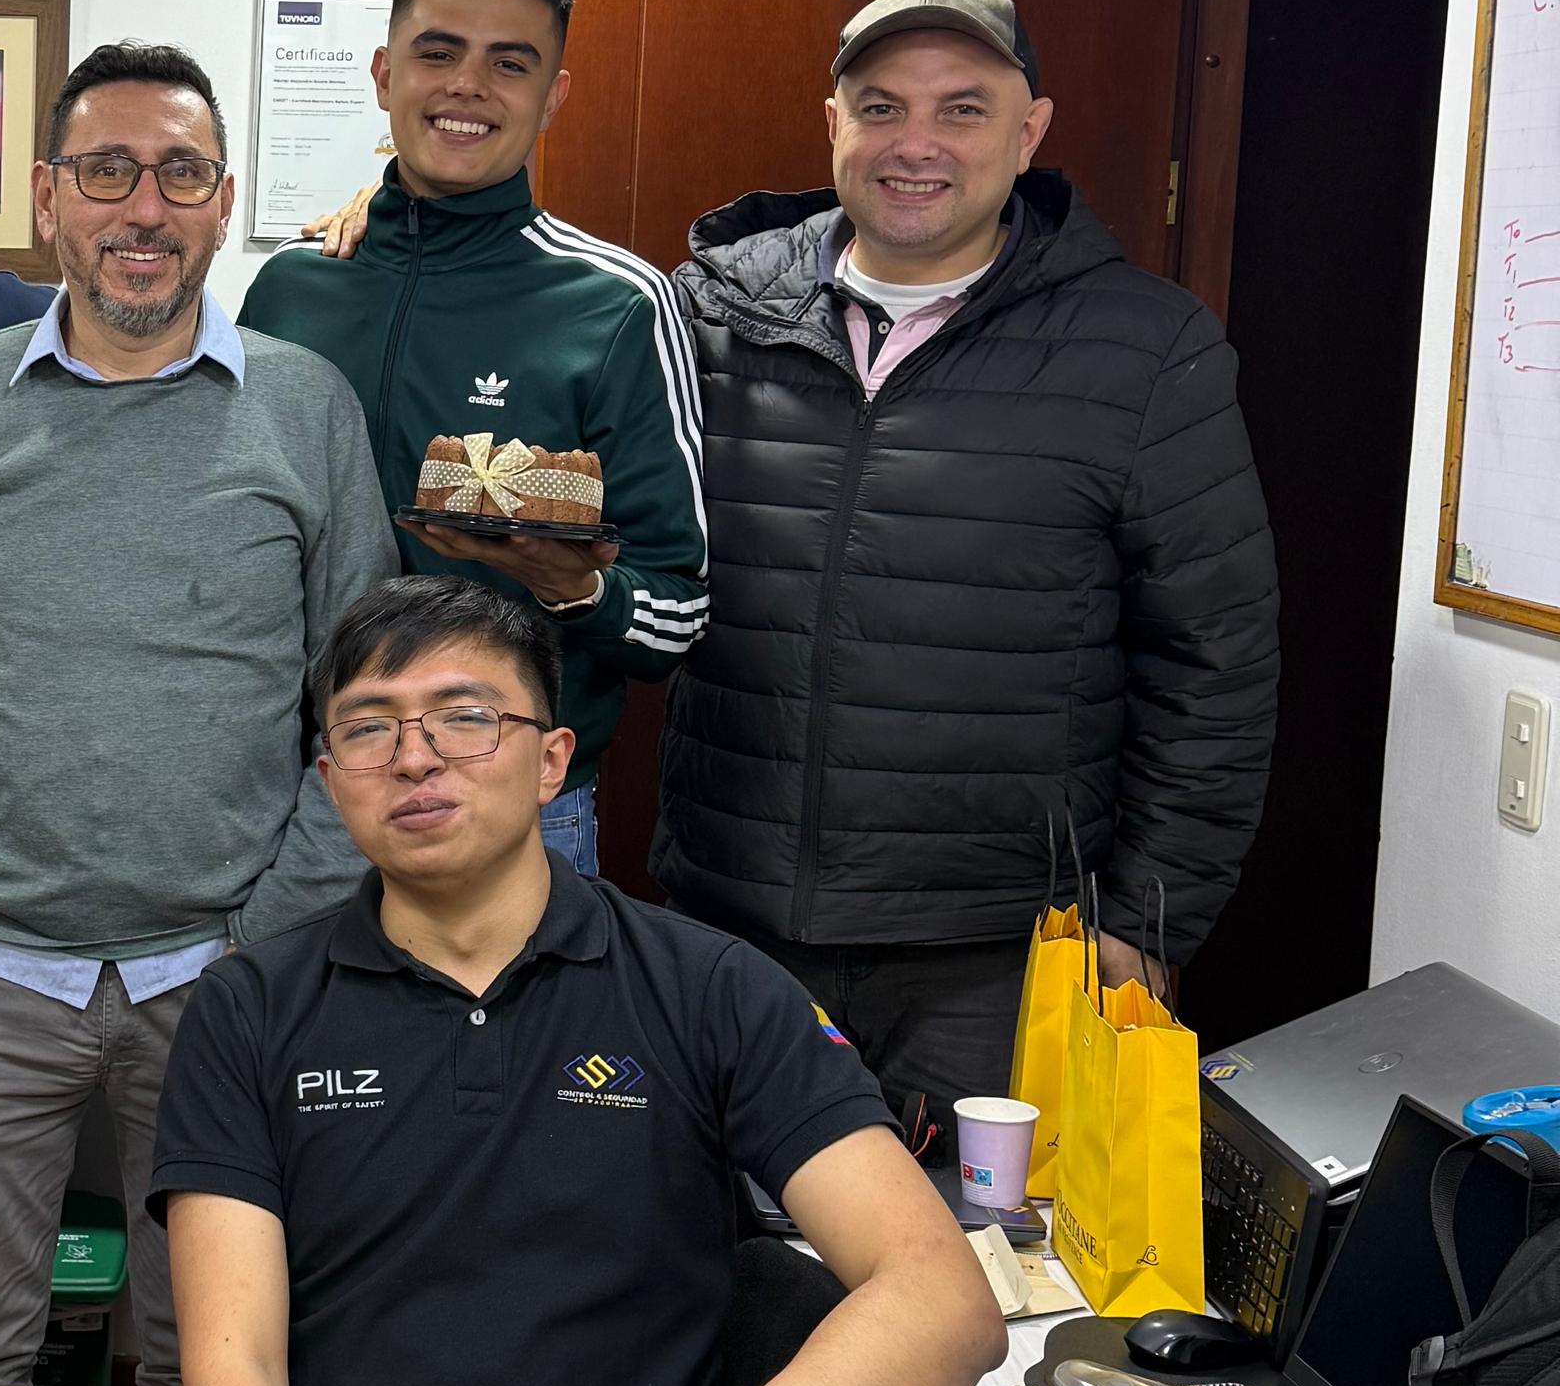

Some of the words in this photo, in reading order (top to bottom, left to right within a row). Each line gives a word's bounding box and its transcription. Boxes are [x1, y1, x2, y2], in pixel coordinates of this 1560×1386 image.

[275, 47, 353, 62] Certificado
[468, 395, 505, 407] adidas
[297, 1069, 383, 1100] PILZ
[557, 1089, 595, 1099] CONTROL
[297, 1105, 312, 1113] THE
[341, 1101, 352, 1109] OF
